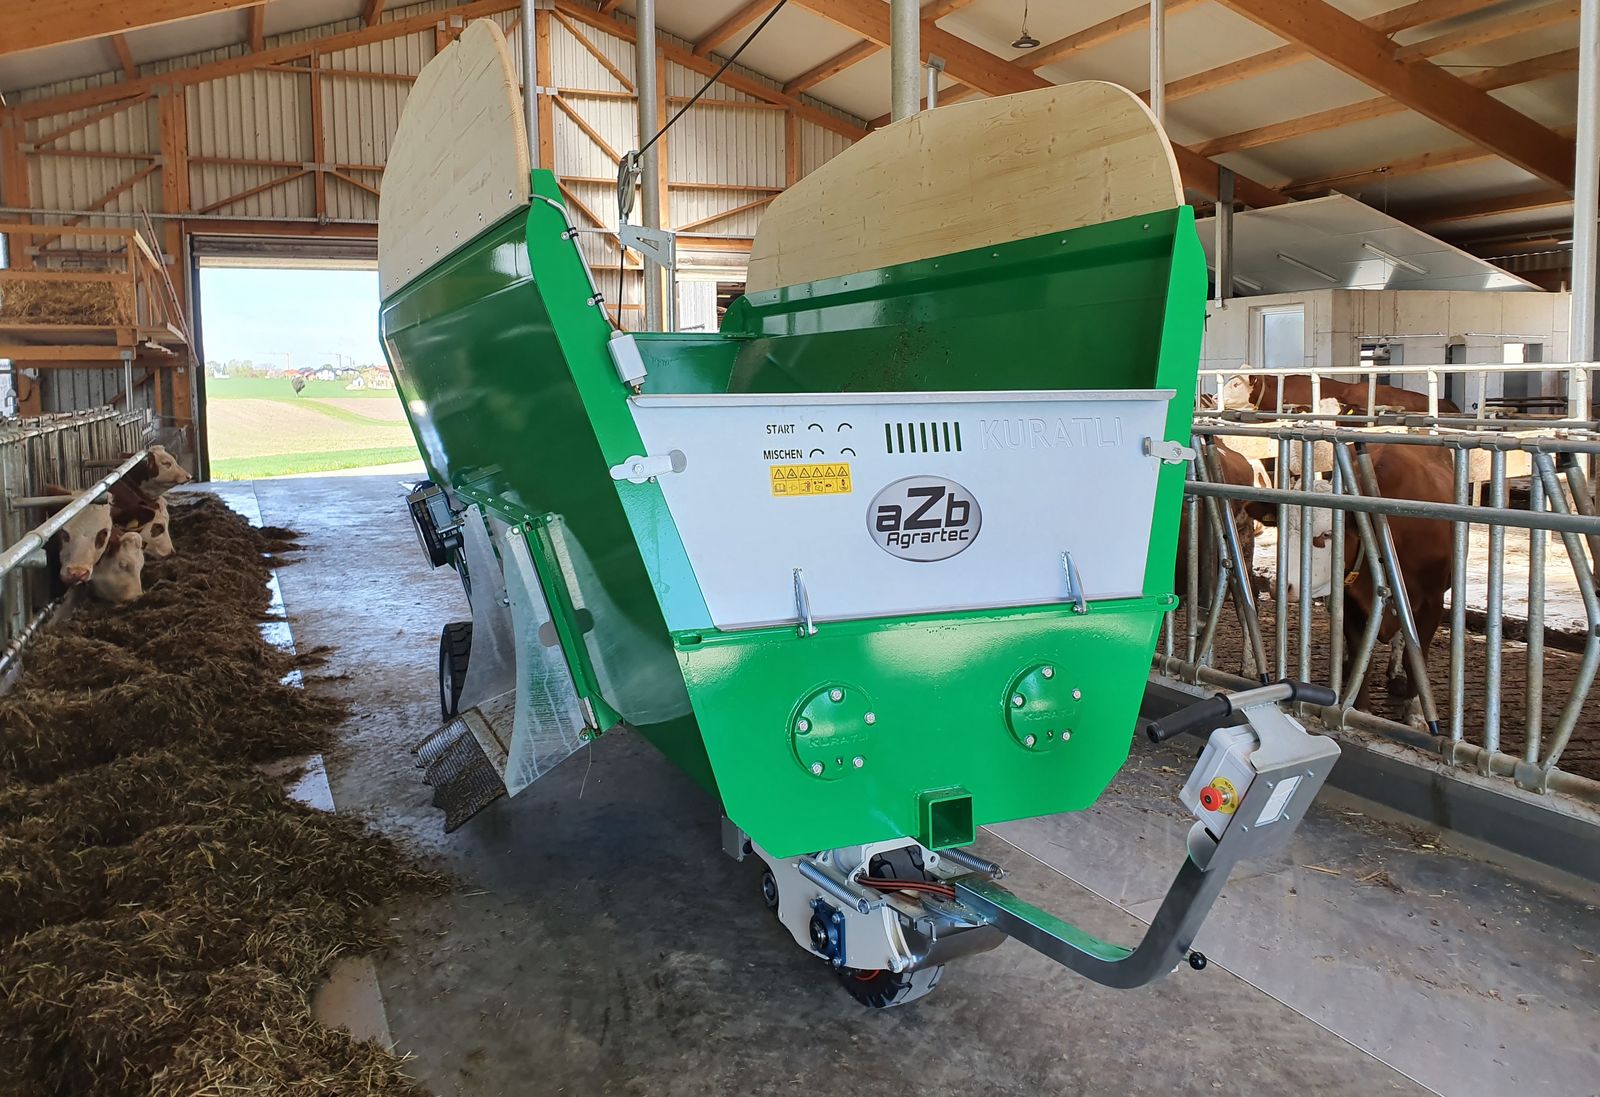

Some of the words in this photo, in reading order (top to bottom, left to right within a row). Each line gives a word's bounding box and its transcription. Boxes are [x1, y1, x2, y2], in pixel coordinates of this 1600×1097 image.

[766, 424, 796, 435] START
[979, 416, 1124, 450] KURATLI
[763, 449, 803, 460] MISCHEN
[876, 486, 971, 532] aZb
[886, 528, 970, 549] Agrartec
